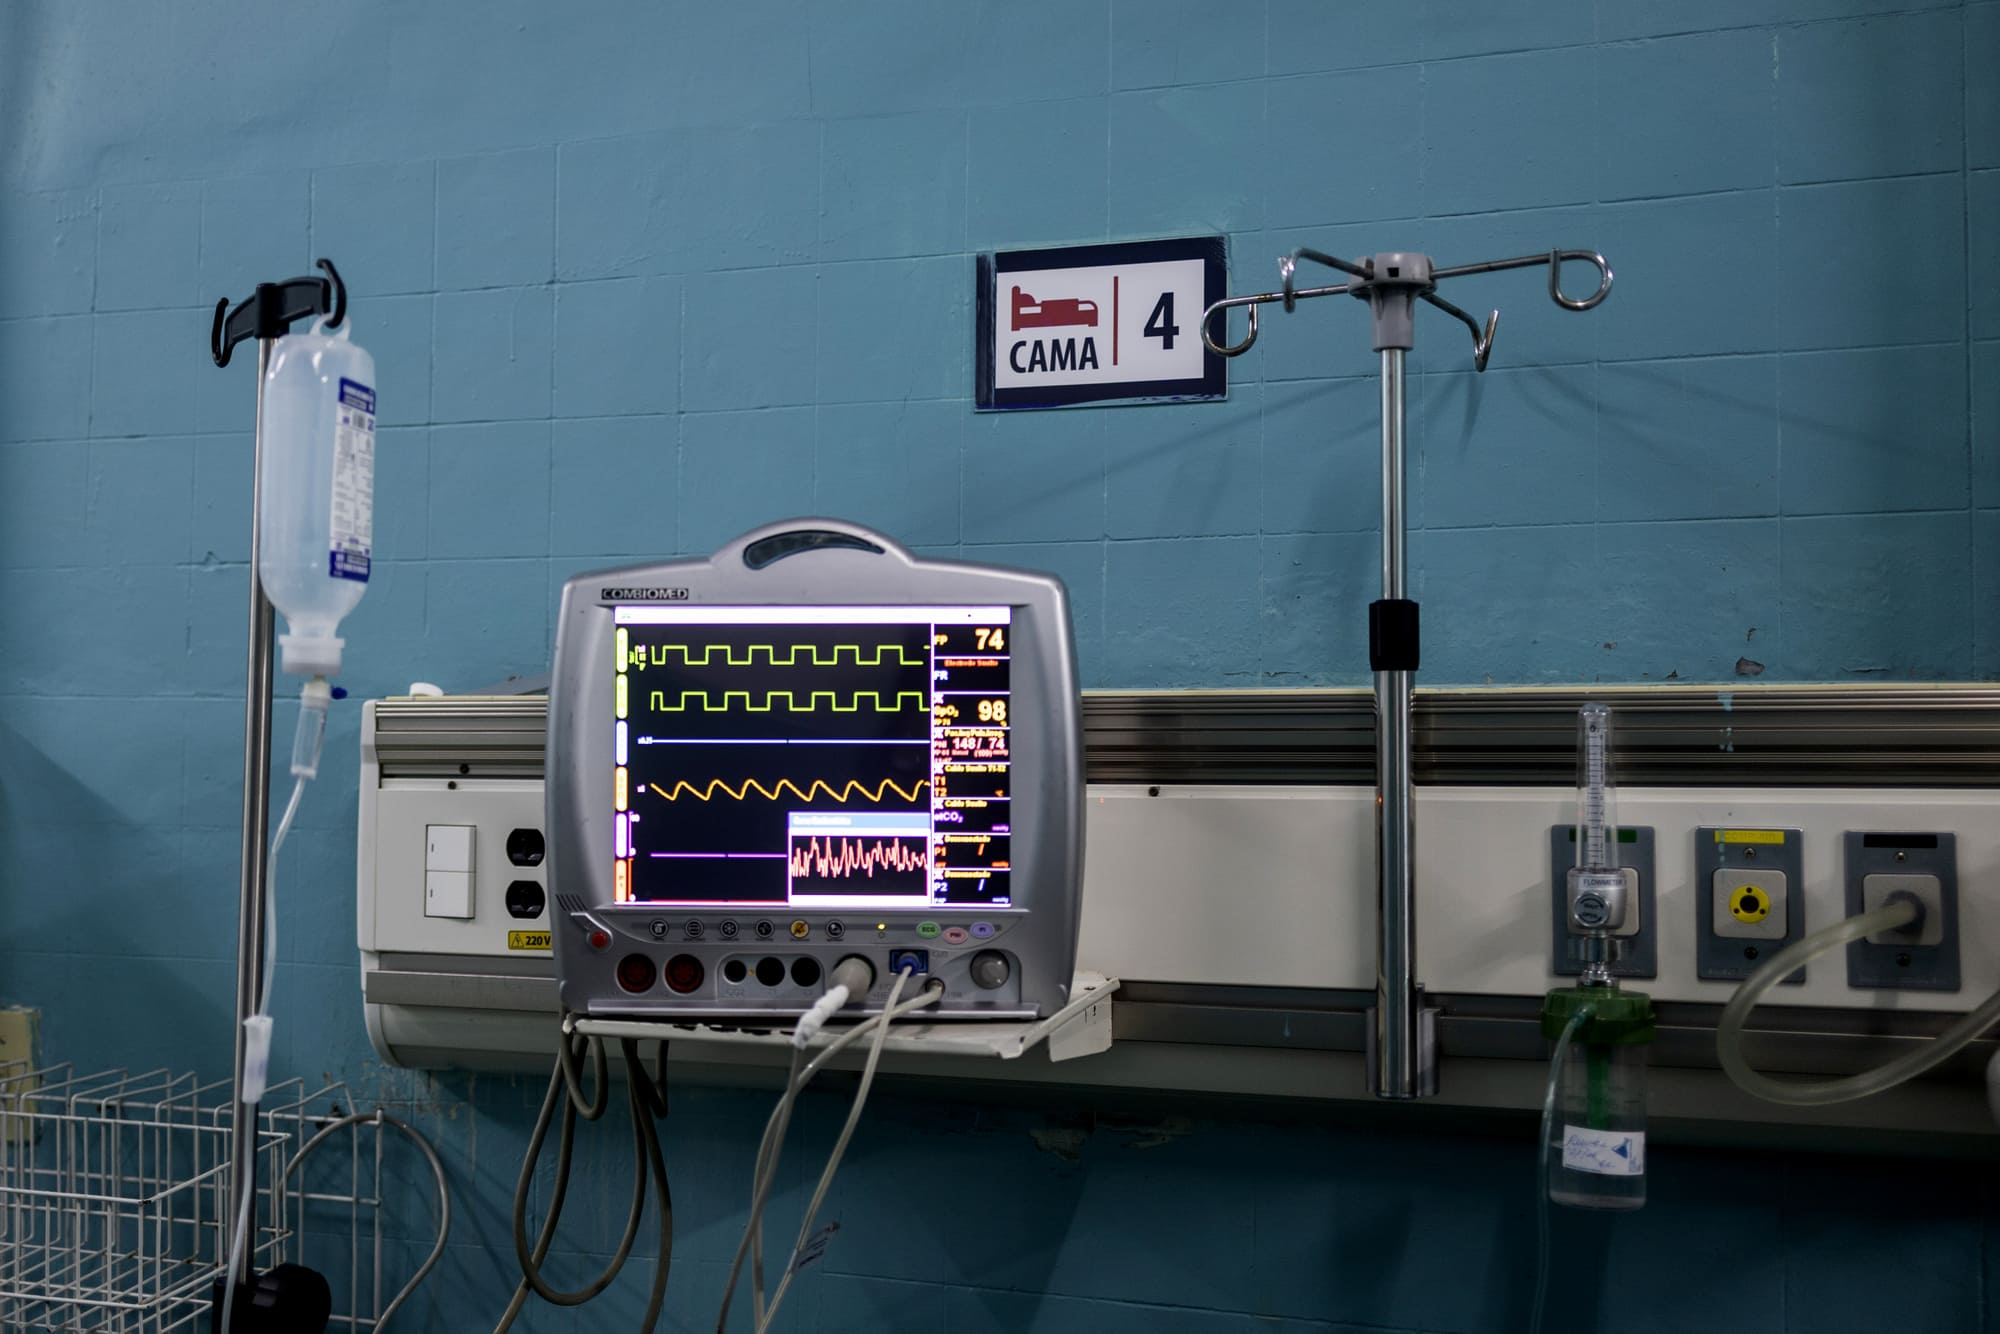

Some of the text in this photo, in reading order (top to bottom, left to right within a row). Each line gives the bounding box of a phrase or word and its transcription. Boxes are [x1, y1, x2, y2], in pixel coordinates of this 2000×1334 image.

[1143, 291, 1180, 350] 4
[1009, 336, 1099, 373] CAMA
[602, 588, 688, 600] COMBIOMED
[975, 627, 1005, 650] 74
[933, 670, 948, 681] FR
[978, 699, 1007, 721] 98
[988, 737, 1006, 750] 74
[934, 776, 947, 786] T1
[934, 787, 948, 797] T2
[934, 846, 947, 857] P1
[933, 882, 949, 892] P2
[525, 935, 543, 946] 220
